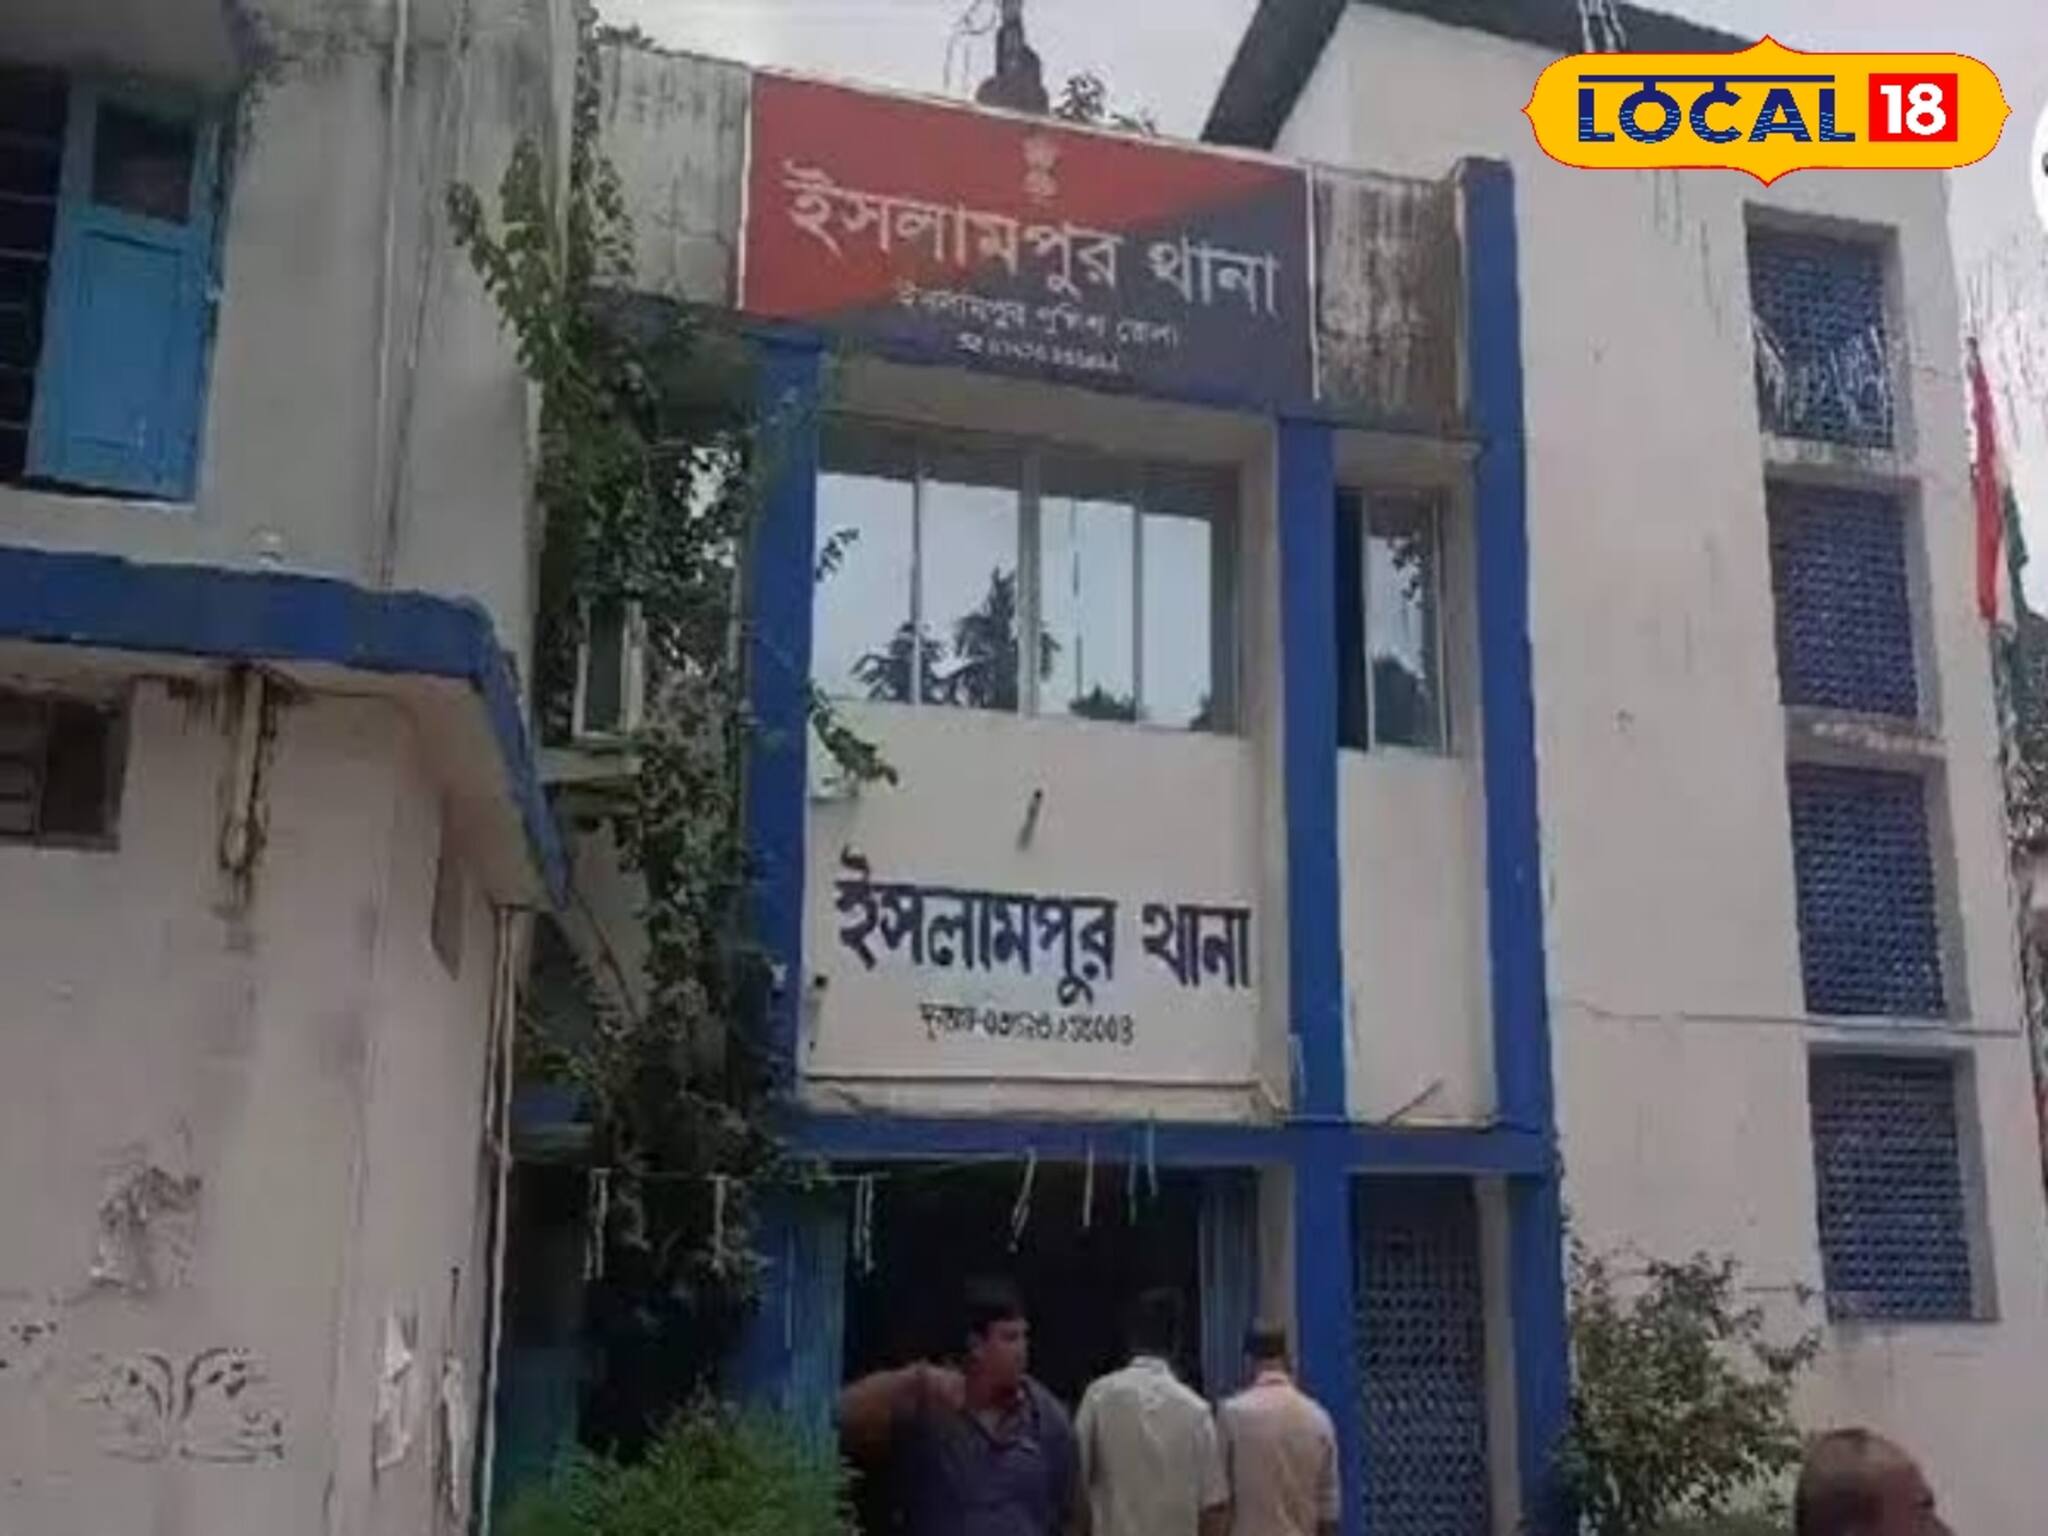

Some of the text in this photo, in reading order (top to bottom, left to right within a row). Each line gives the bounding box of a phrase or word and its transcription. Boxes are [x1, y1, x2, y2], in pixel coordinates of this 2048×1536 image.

[784, 159, 1277, 315] ইসলামপুর থানা
[835, 846, 1251, 1006] ইসলামপুর থানা
